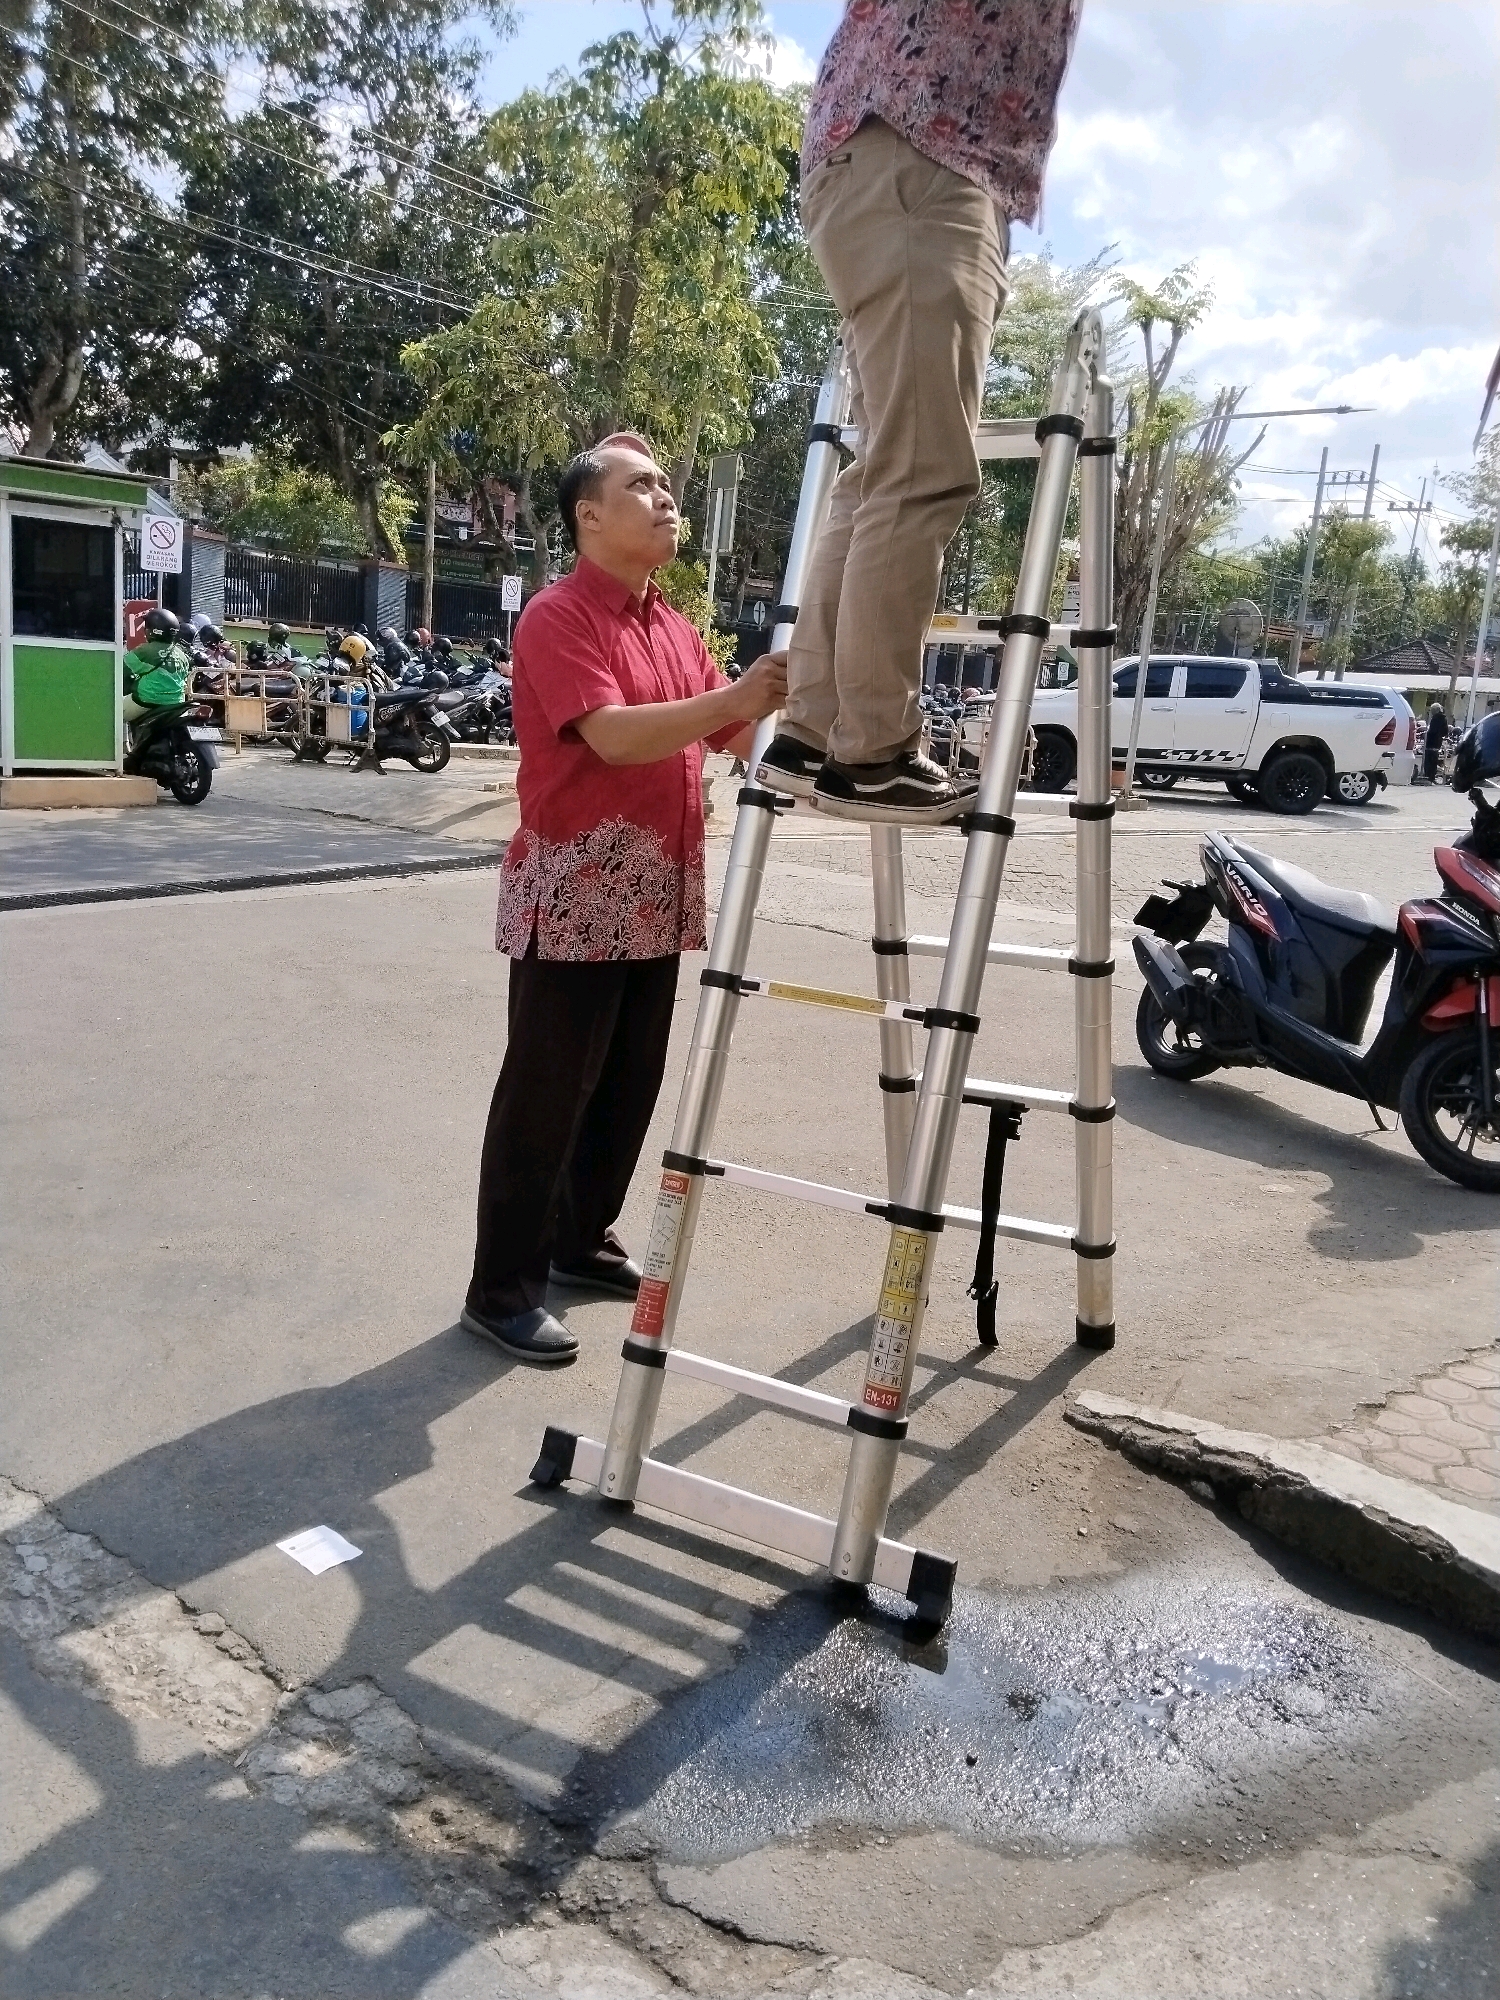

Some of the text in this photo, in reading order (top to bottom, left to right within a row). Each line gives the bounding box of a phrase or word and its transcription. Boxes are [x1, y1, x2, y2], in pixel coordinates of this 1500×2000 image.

[146, 554, 178, 564] DILARANG
[149, 549, 175, 557] KAWASAN
[146, 560, 178, 569] MEROKOK
[1226, 862, 1269, 916] VARIO
[1451, 901, 1481, 926] HONDA
[865, 1388, 898, 1407] EN-131
